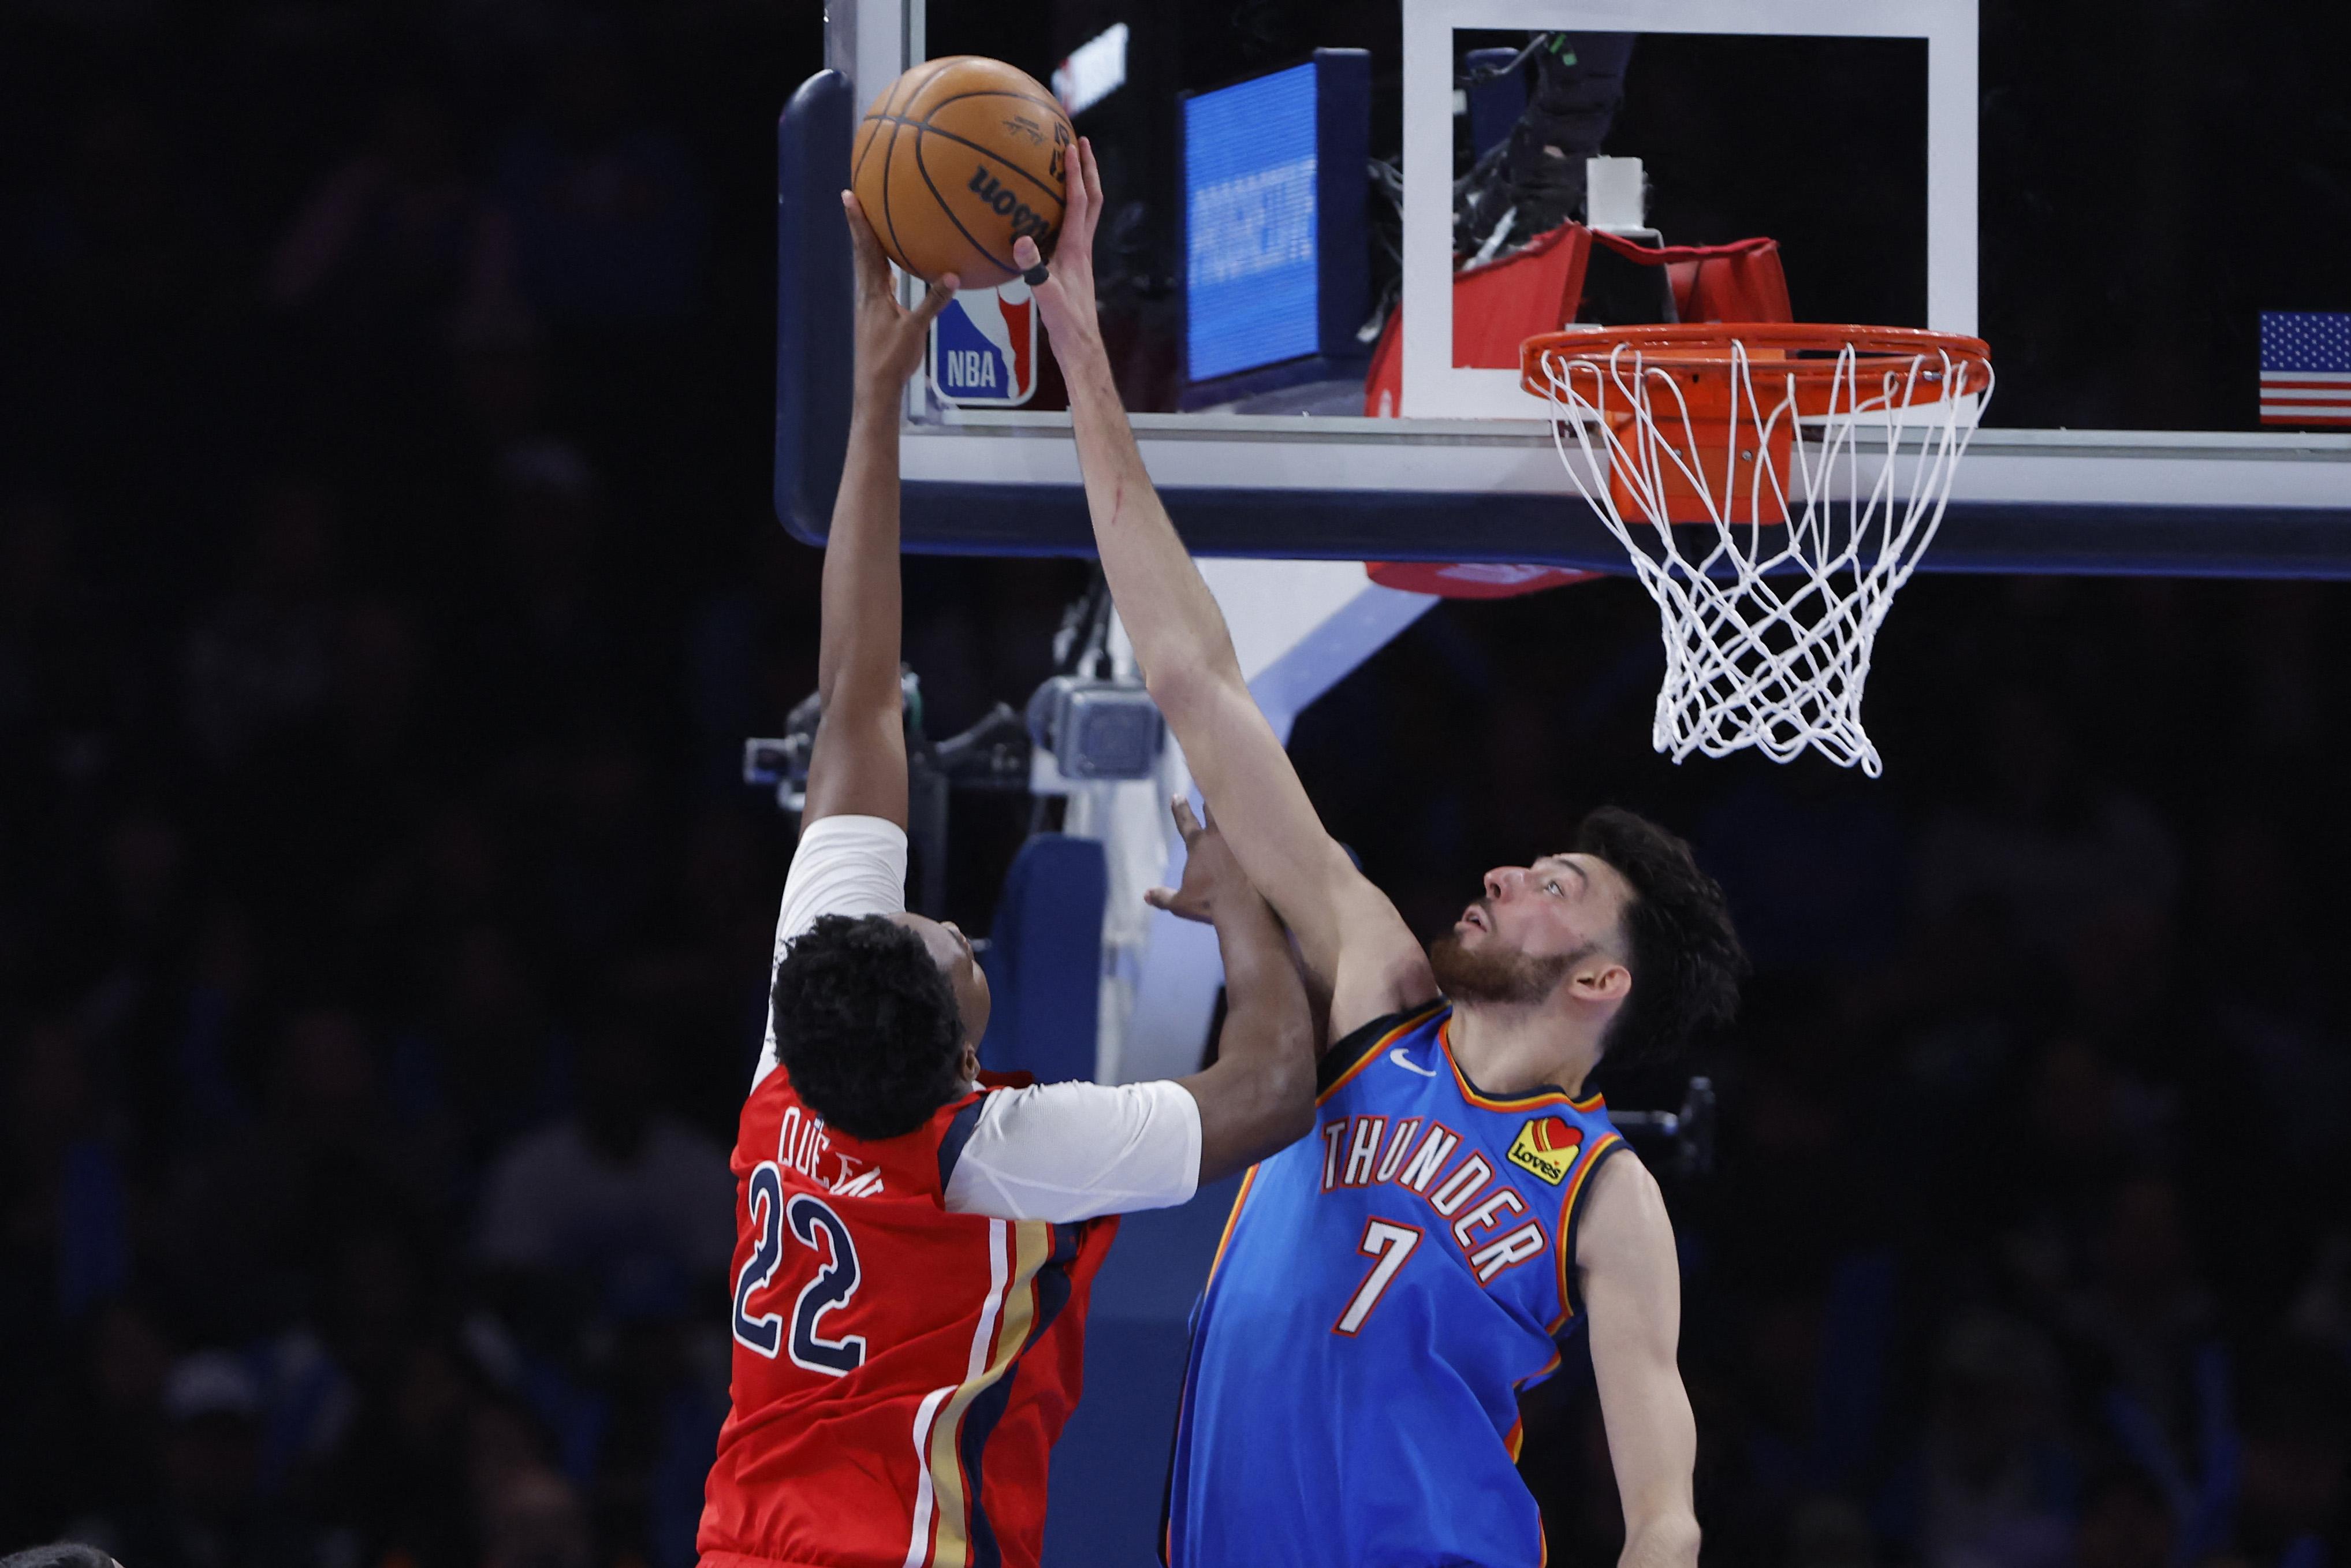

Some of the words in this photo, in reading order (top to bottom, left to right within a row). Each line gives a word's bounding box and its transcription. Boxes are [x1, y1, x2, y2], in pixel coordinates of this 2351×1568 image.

[947, 349, 997, 388] NBA
[732, 1160, 866, 1377] 22
[1321, 1115, 1549, 1288] THUNDER
[1331, 1215, 1425, 1338] 7
